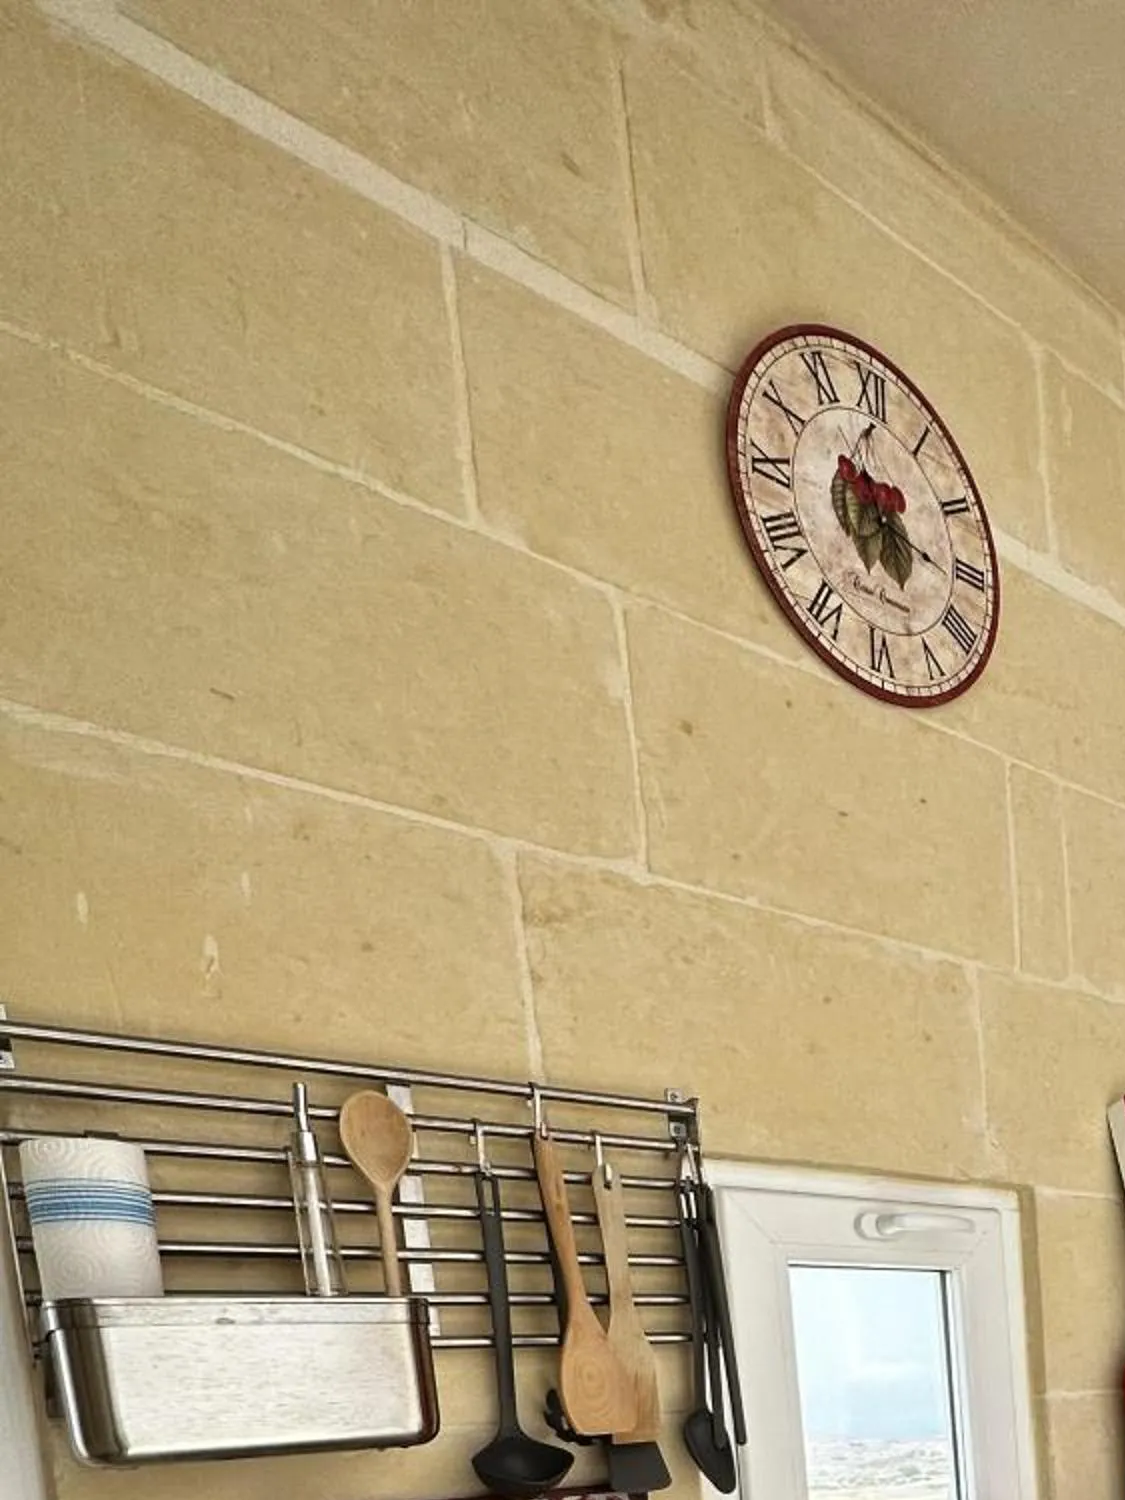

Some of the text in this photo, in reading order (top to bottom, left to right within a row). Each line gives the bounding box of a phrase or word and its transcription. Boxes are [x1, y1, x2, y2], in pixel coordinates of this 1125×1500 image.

[801, 351, 840, 404] XI
[854, 361, 888, 424] XII
[762, 380, 806, 436] X
[750, 441, 792, 489] IX
[913, 426, 931, 457] I
[941, 496, 971, 516] II
[761, 510, 808, 570] VIII
[954, 557, 986, 592] III
[807, 580, 844, 641] VII
[942, 604, 979, 656] IIII
[869, 626, 895, 678] VI
[922, 637, 947, 681] V
